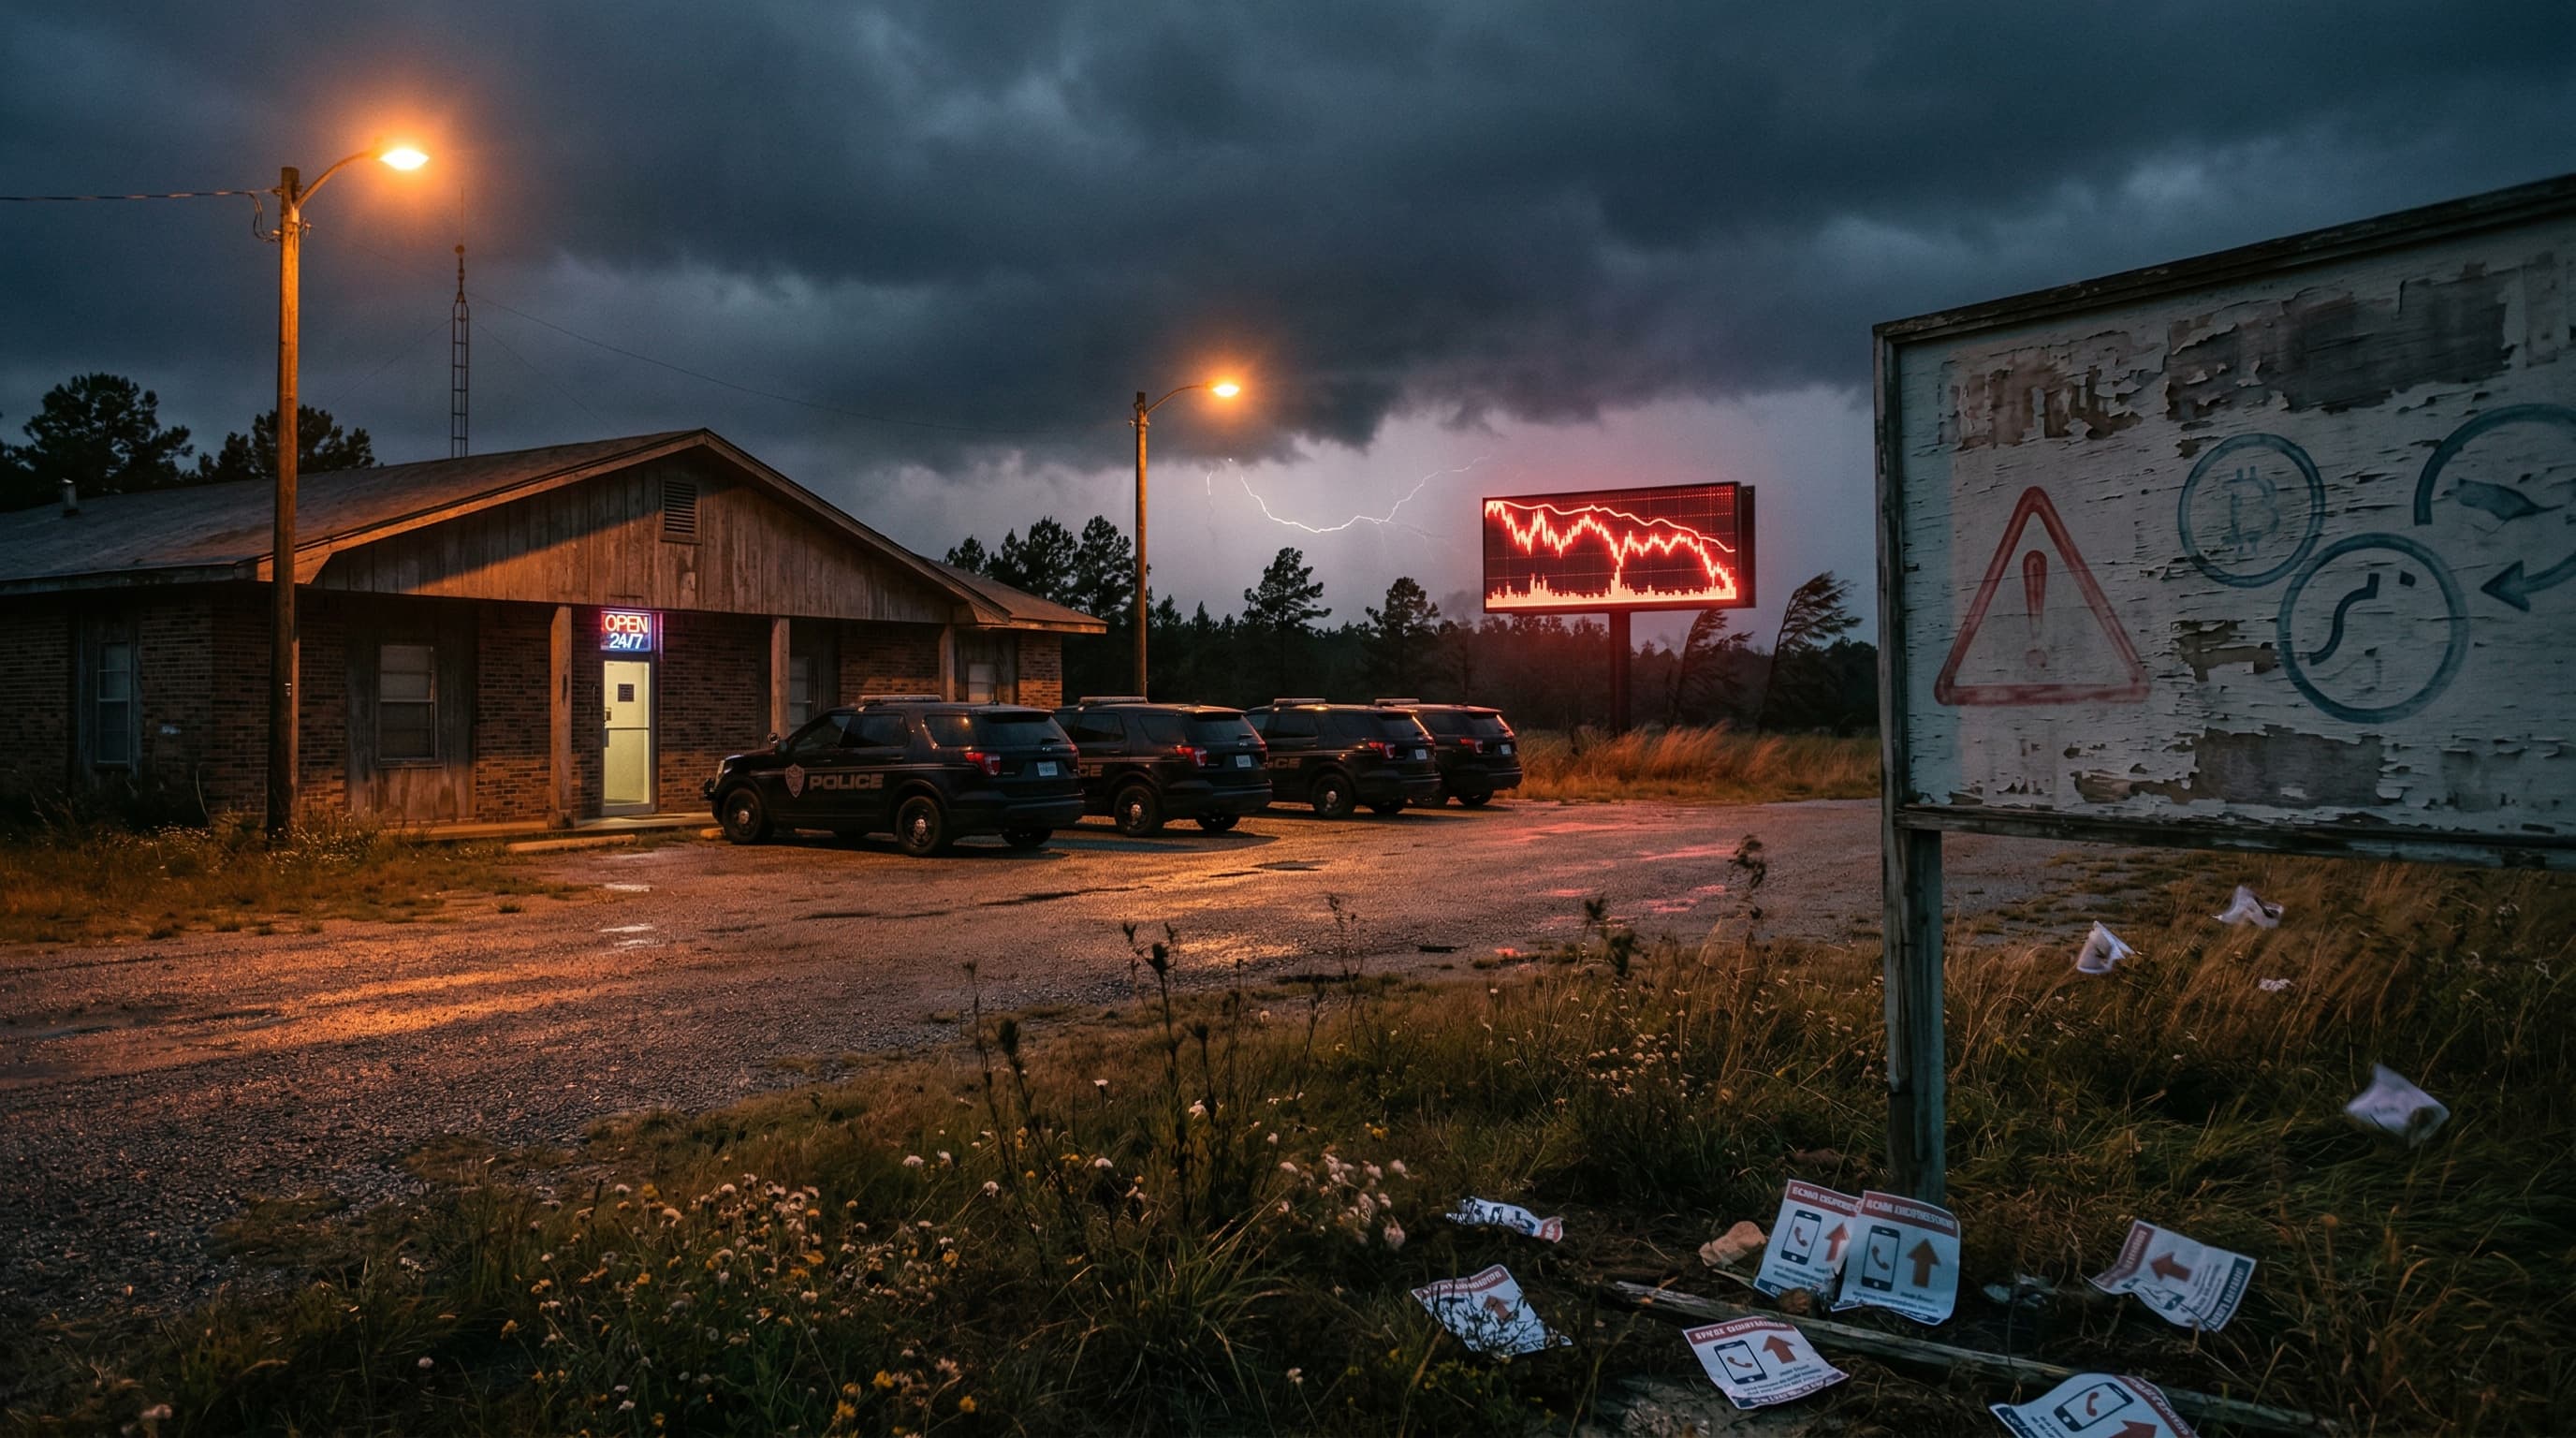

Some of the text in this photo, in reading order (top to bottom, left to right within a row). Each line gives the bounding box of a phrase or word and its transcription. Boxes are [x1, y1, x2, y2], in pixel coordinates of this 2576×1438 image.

[605, 614, 649, 633] OPEN
[609, 633, 644, 649] 24/7
[809, 773, 885, 790] POLICE
